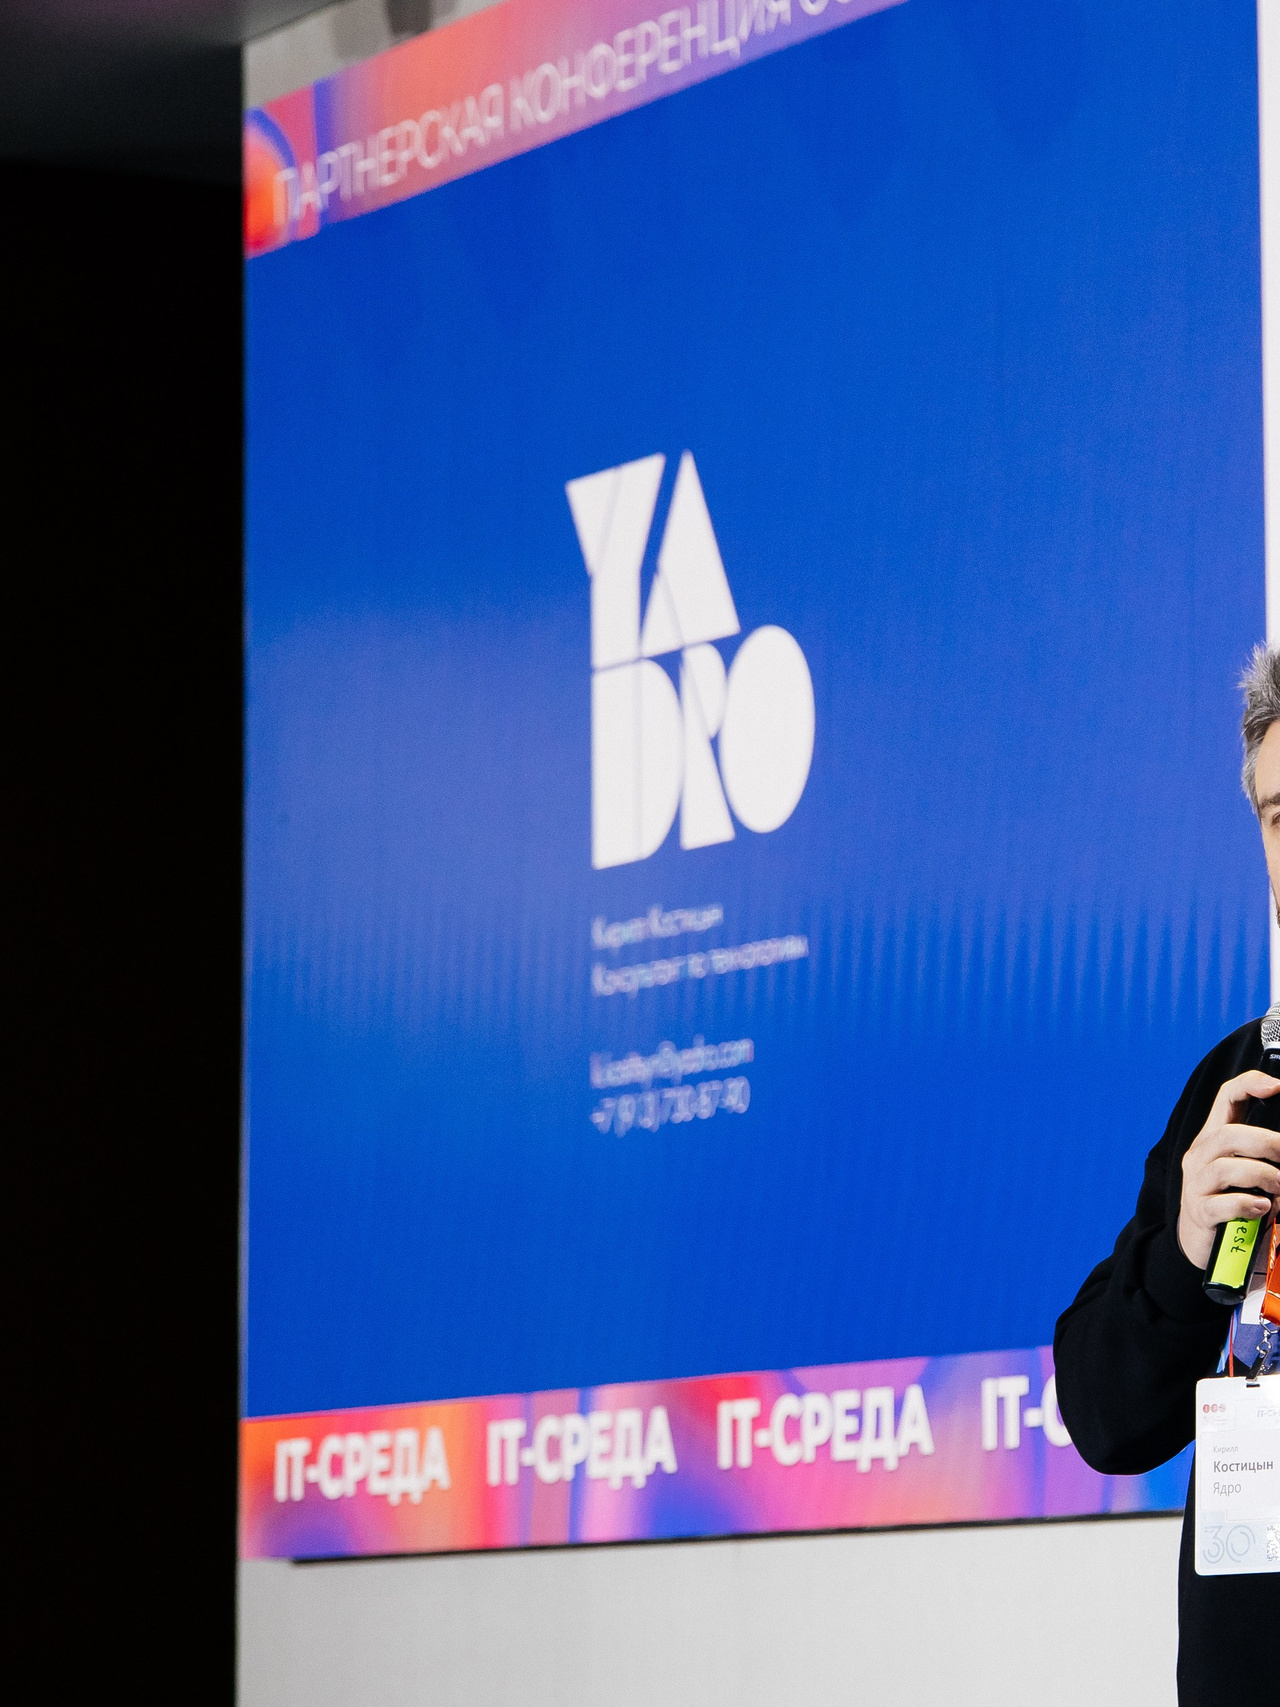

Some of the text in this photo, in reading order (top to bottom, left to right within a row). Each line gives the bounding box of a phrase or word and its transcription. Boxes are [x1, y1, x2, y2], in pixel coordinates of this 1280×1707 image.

[272, 83, 506, 226] ПАРТНЕРСКАЯ
[565, 449, 741, 672] YA
[590, 624, 816, 870] DRO
[273, 1374, 1073, 1504] IT-СРЕДА IT-СРЕДА IT-СРЕДА IT-С
[1213, 1446, 1239, 1455] Кирилл
[1213, 1460, 1274, 1474] Костицын
[1213, 1482, 1242, 1497] Ядро
[1203, 1524, 1256, 1565] 30
